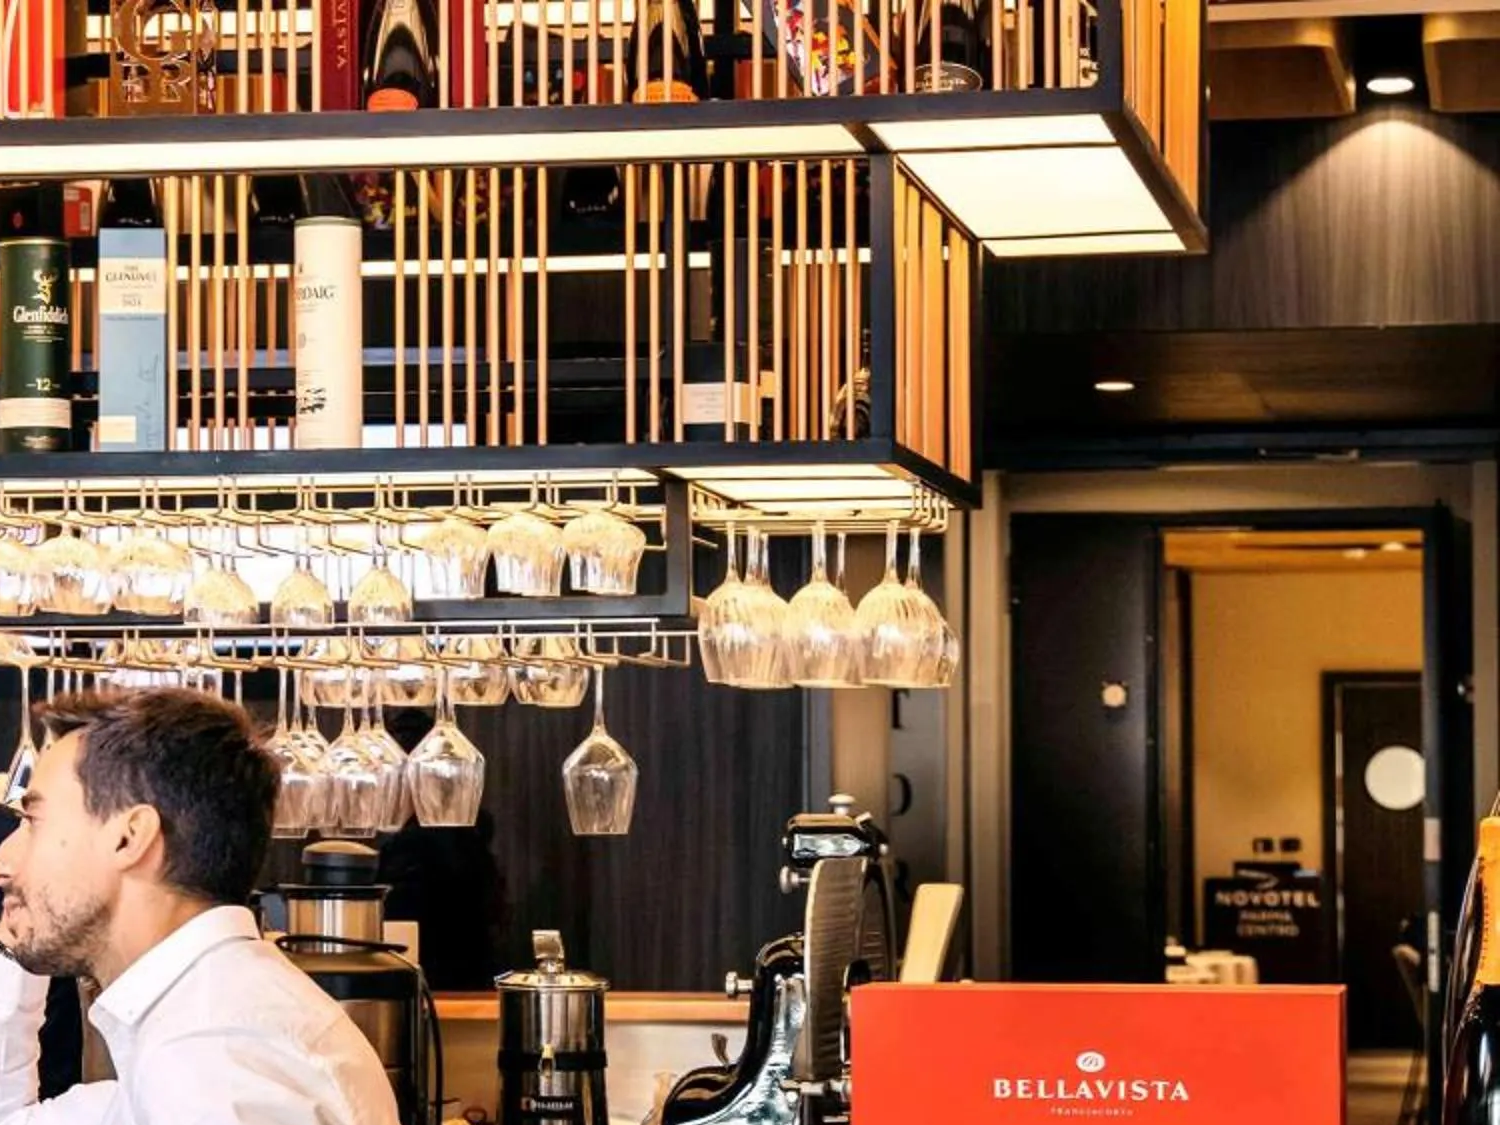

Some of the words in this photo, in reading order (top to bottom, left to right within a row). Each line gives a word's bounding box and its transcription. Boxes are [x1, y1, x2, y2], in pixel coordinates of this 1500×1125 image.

[35, 378, 51, 391] 12
[1215, 891, 1320, 907] NOVOTEL
[993, 1079, 1189, 1101] BELLAVISTA
